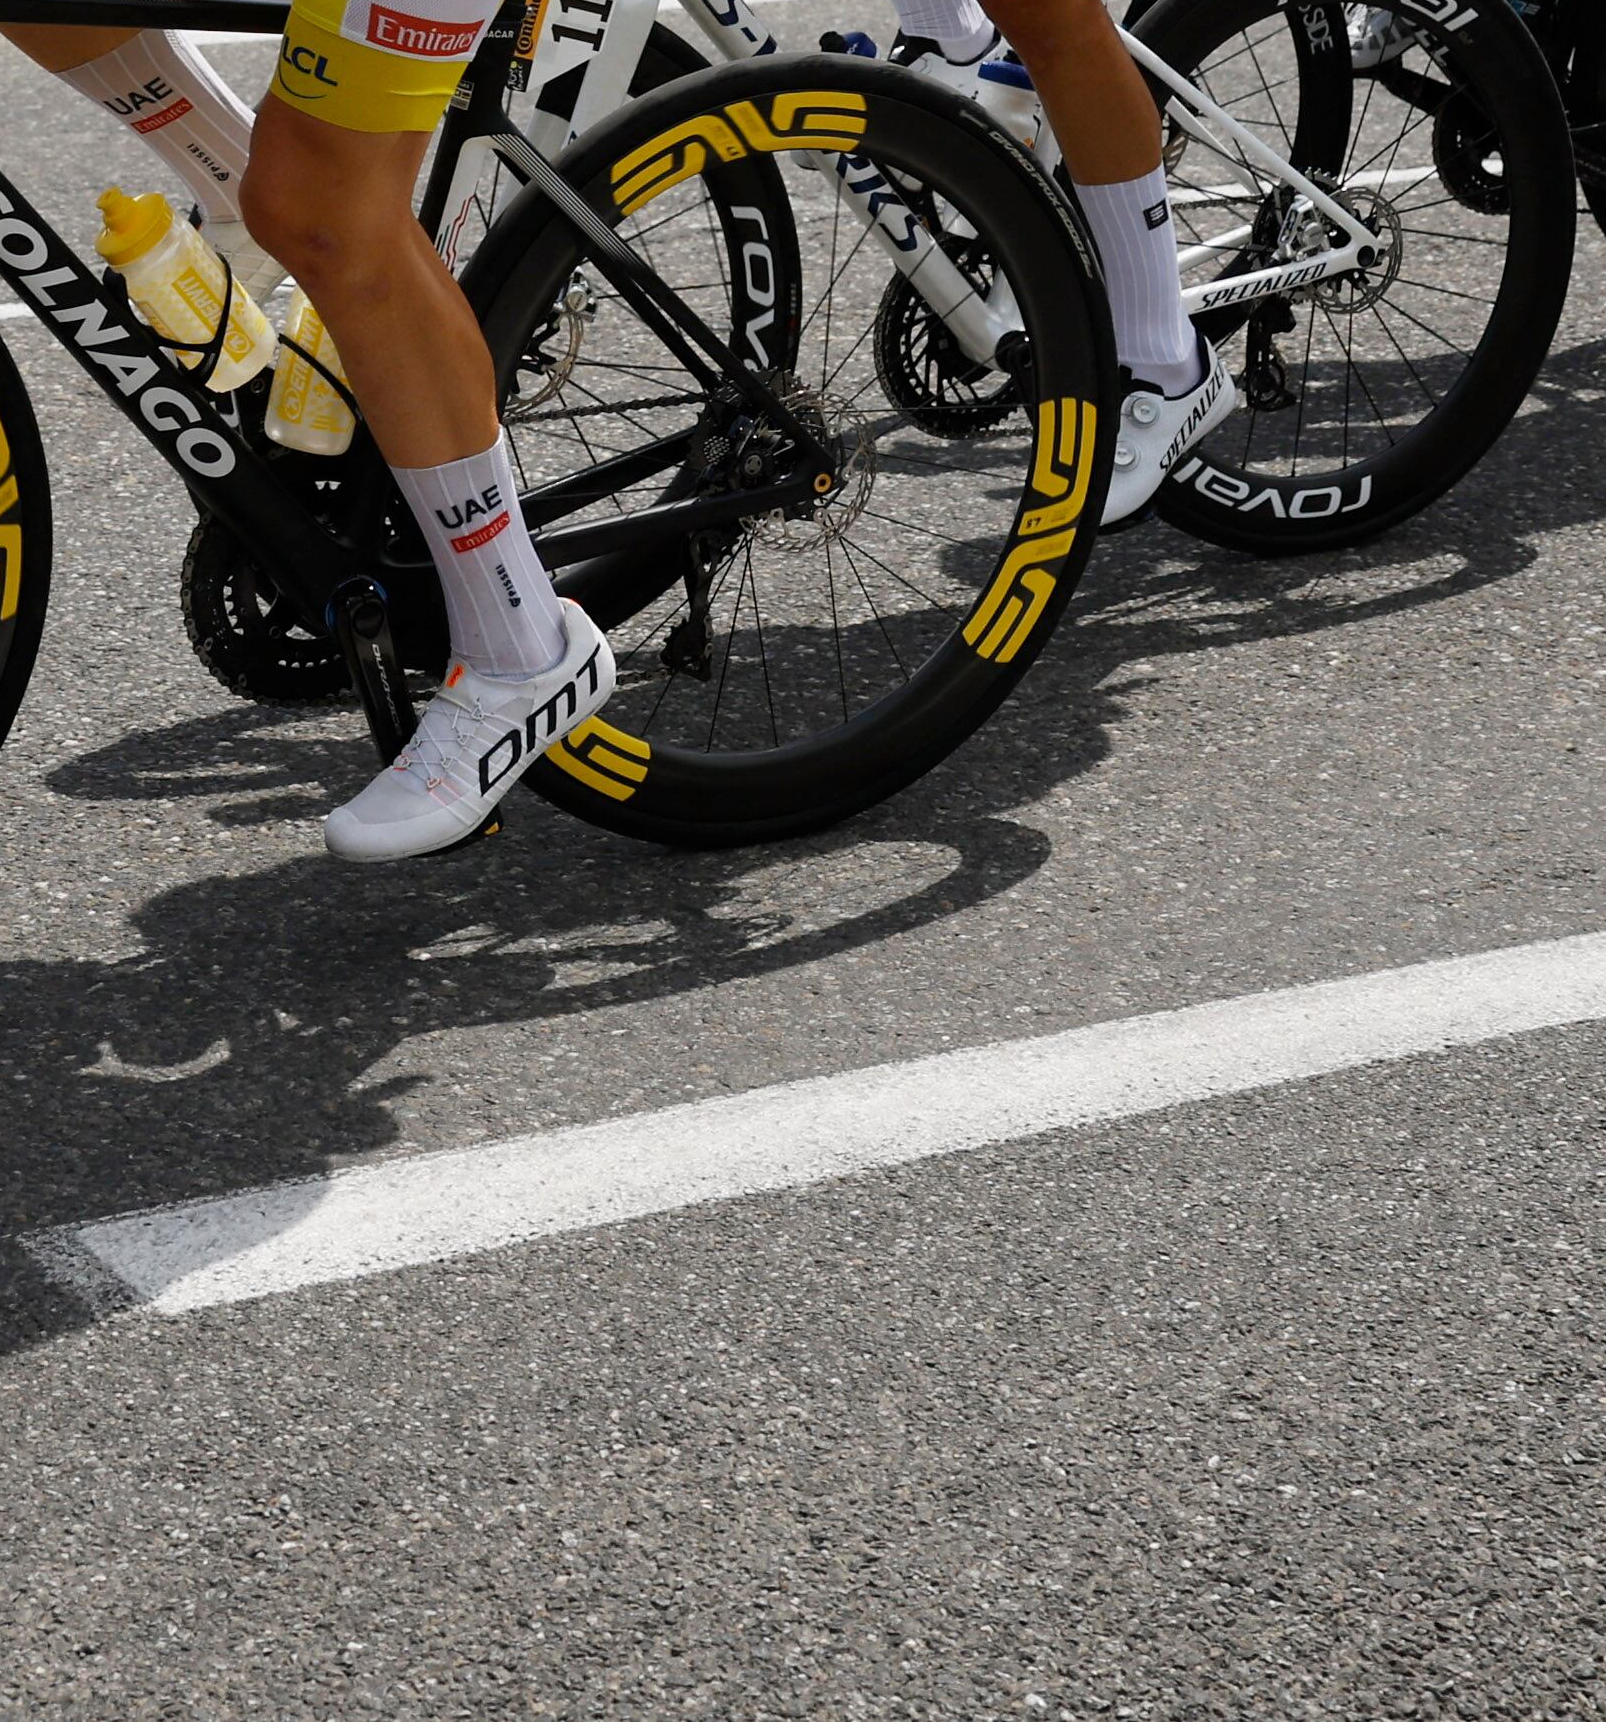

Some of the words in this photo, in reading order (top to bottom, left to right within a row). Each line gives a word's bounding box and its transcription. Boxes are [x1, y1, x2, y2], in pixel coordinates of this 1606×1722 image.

[375, 17, 484, 54] Emirates
[281, 34, 339, 88] LCL
[102, 76, 174, 115] UAE
[133, 100, 191, 132] Emirates
[186, 143, 222, 176] PISSEI
[989, 131, 1035, 174] GRAND
[1201, 261, 1328, 311] SPECIALIZED
[435, 484, 504, 530] UAE
[1171, 456, 1373, 521] roval
[454, 513, 511, 551] Emirates
[495, 564, 518, 598] PISSEI
